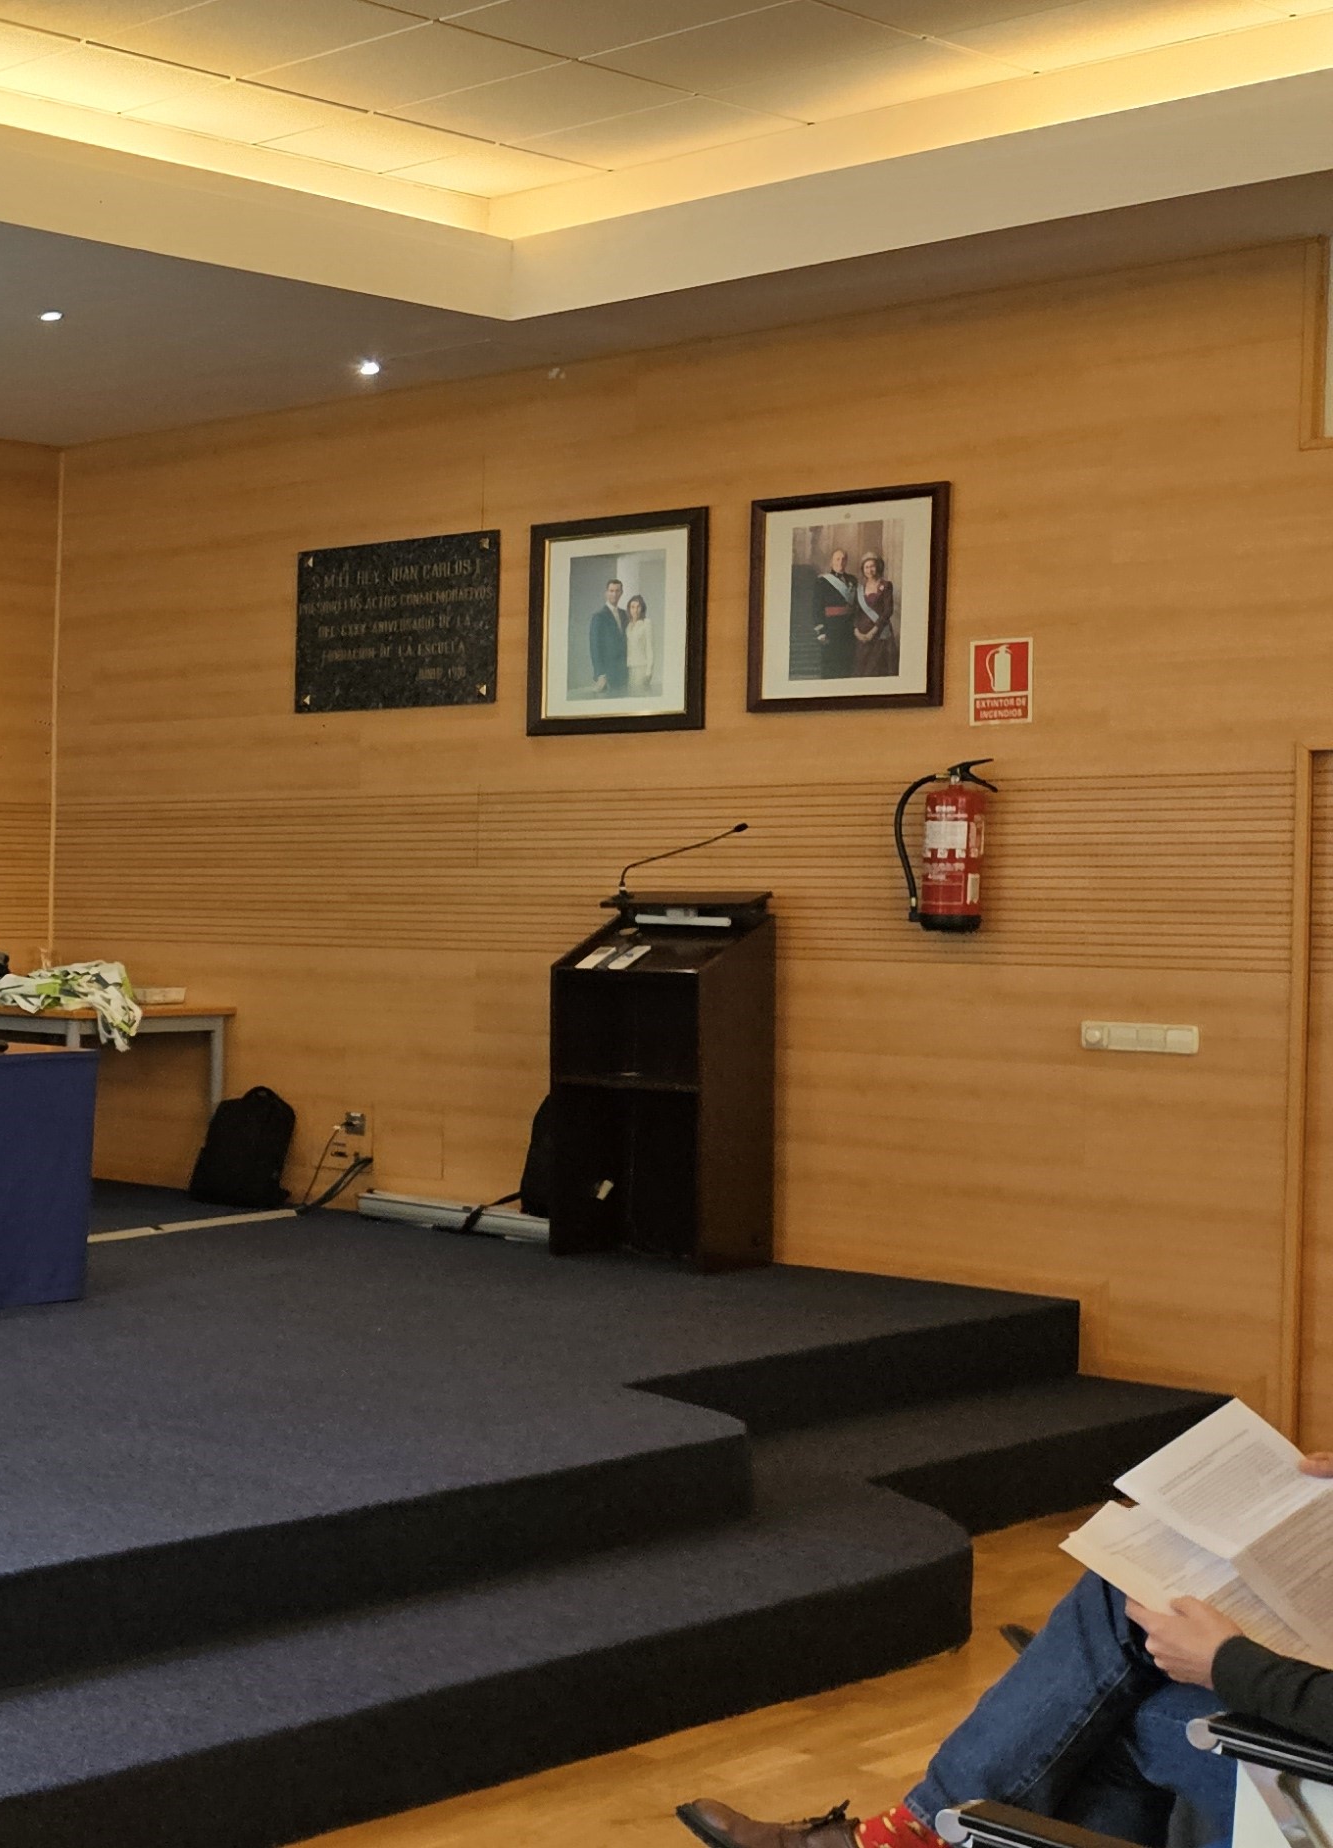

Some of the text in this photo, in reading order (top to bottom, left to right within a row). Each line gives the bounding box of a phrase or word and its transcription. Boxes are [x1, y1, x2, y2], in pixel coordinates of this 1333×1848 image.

[976, 697, 1026, 708] EXTINTOR DE
[980, 708, 1022, 718] INCENDIOS
